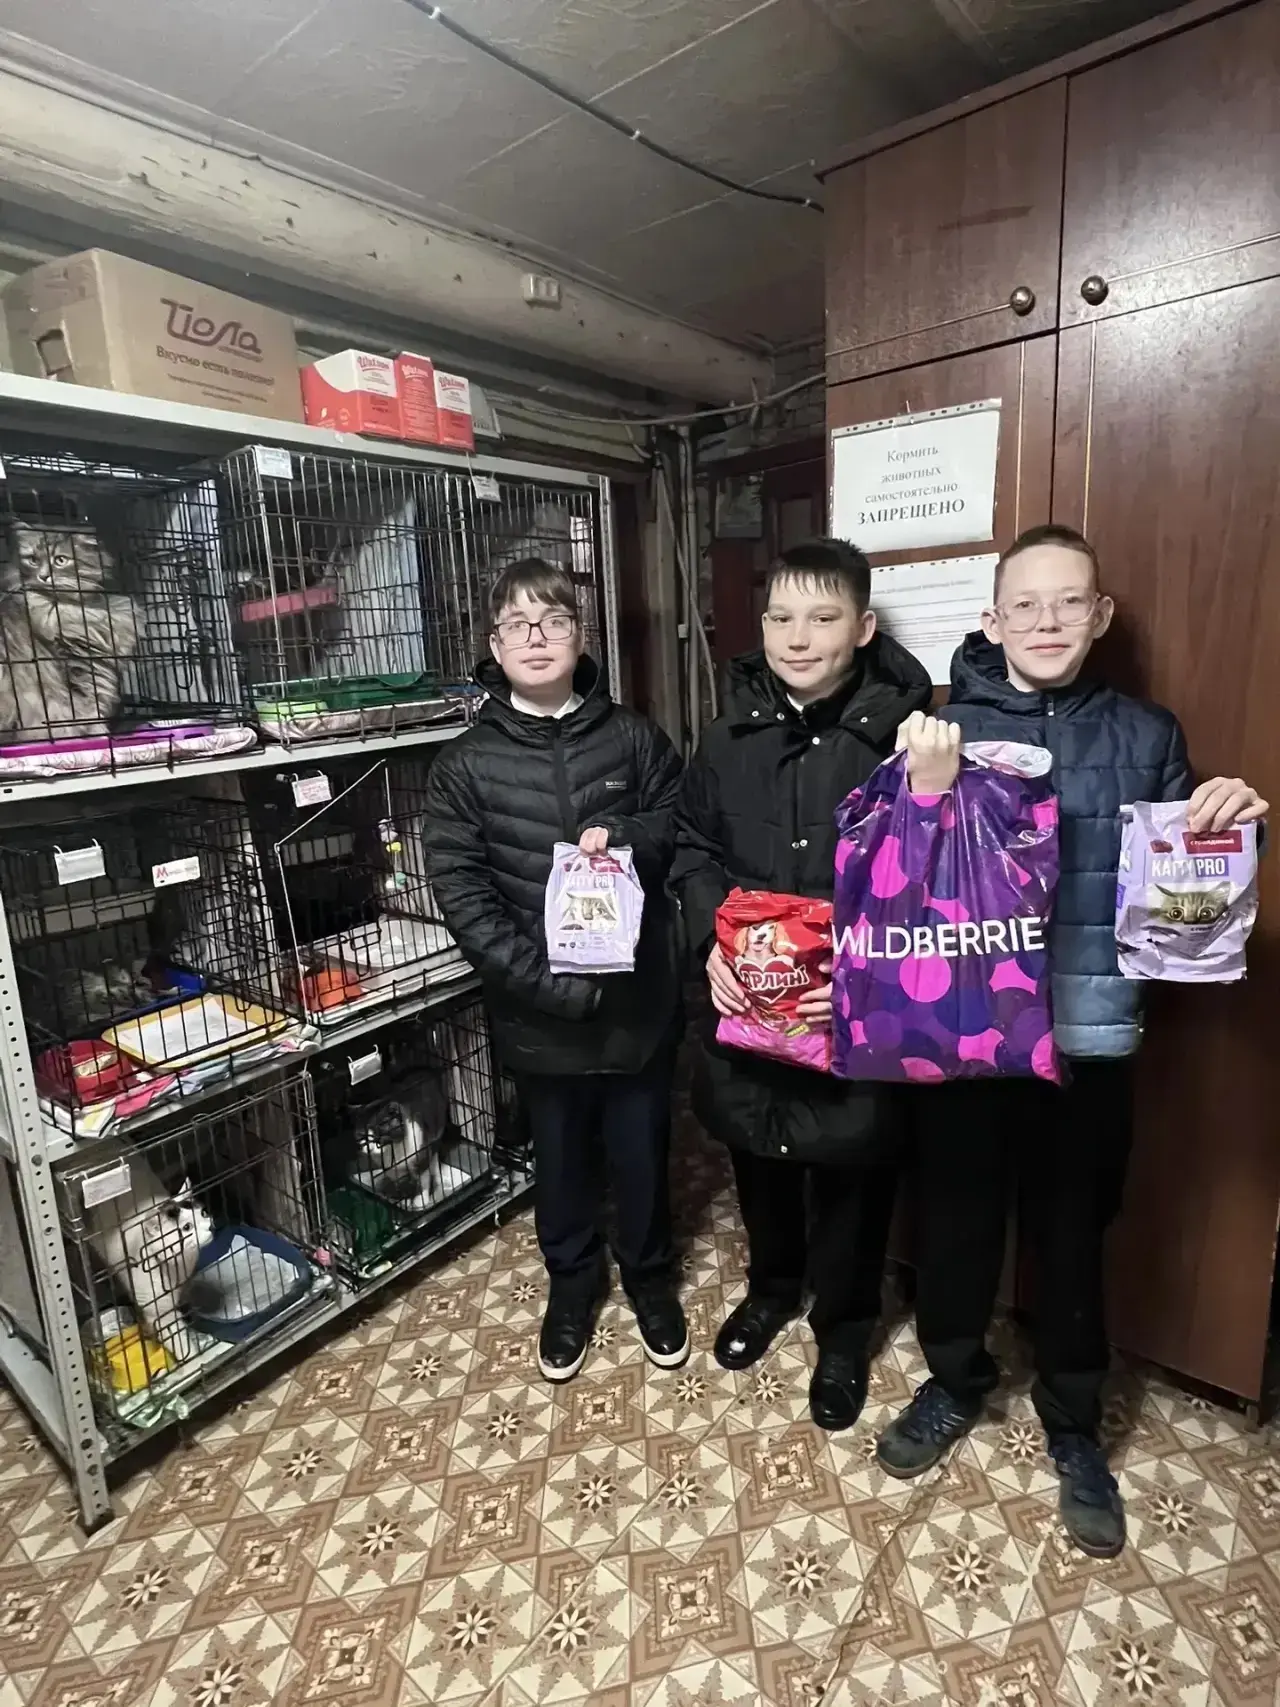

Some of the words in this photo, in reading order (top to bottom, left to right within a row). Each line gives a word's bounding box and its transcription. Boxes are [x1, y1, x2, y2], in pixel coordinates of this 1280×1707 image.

[887, 446, 939, 463] Кормить
[881, 466, 942, 484] животных
[865, 482, 959, 504] самостоятельно
[857, 498, 965, 525] ЗАПРЕЩЕНО
[1196, 857, 1226, 876] PRO
